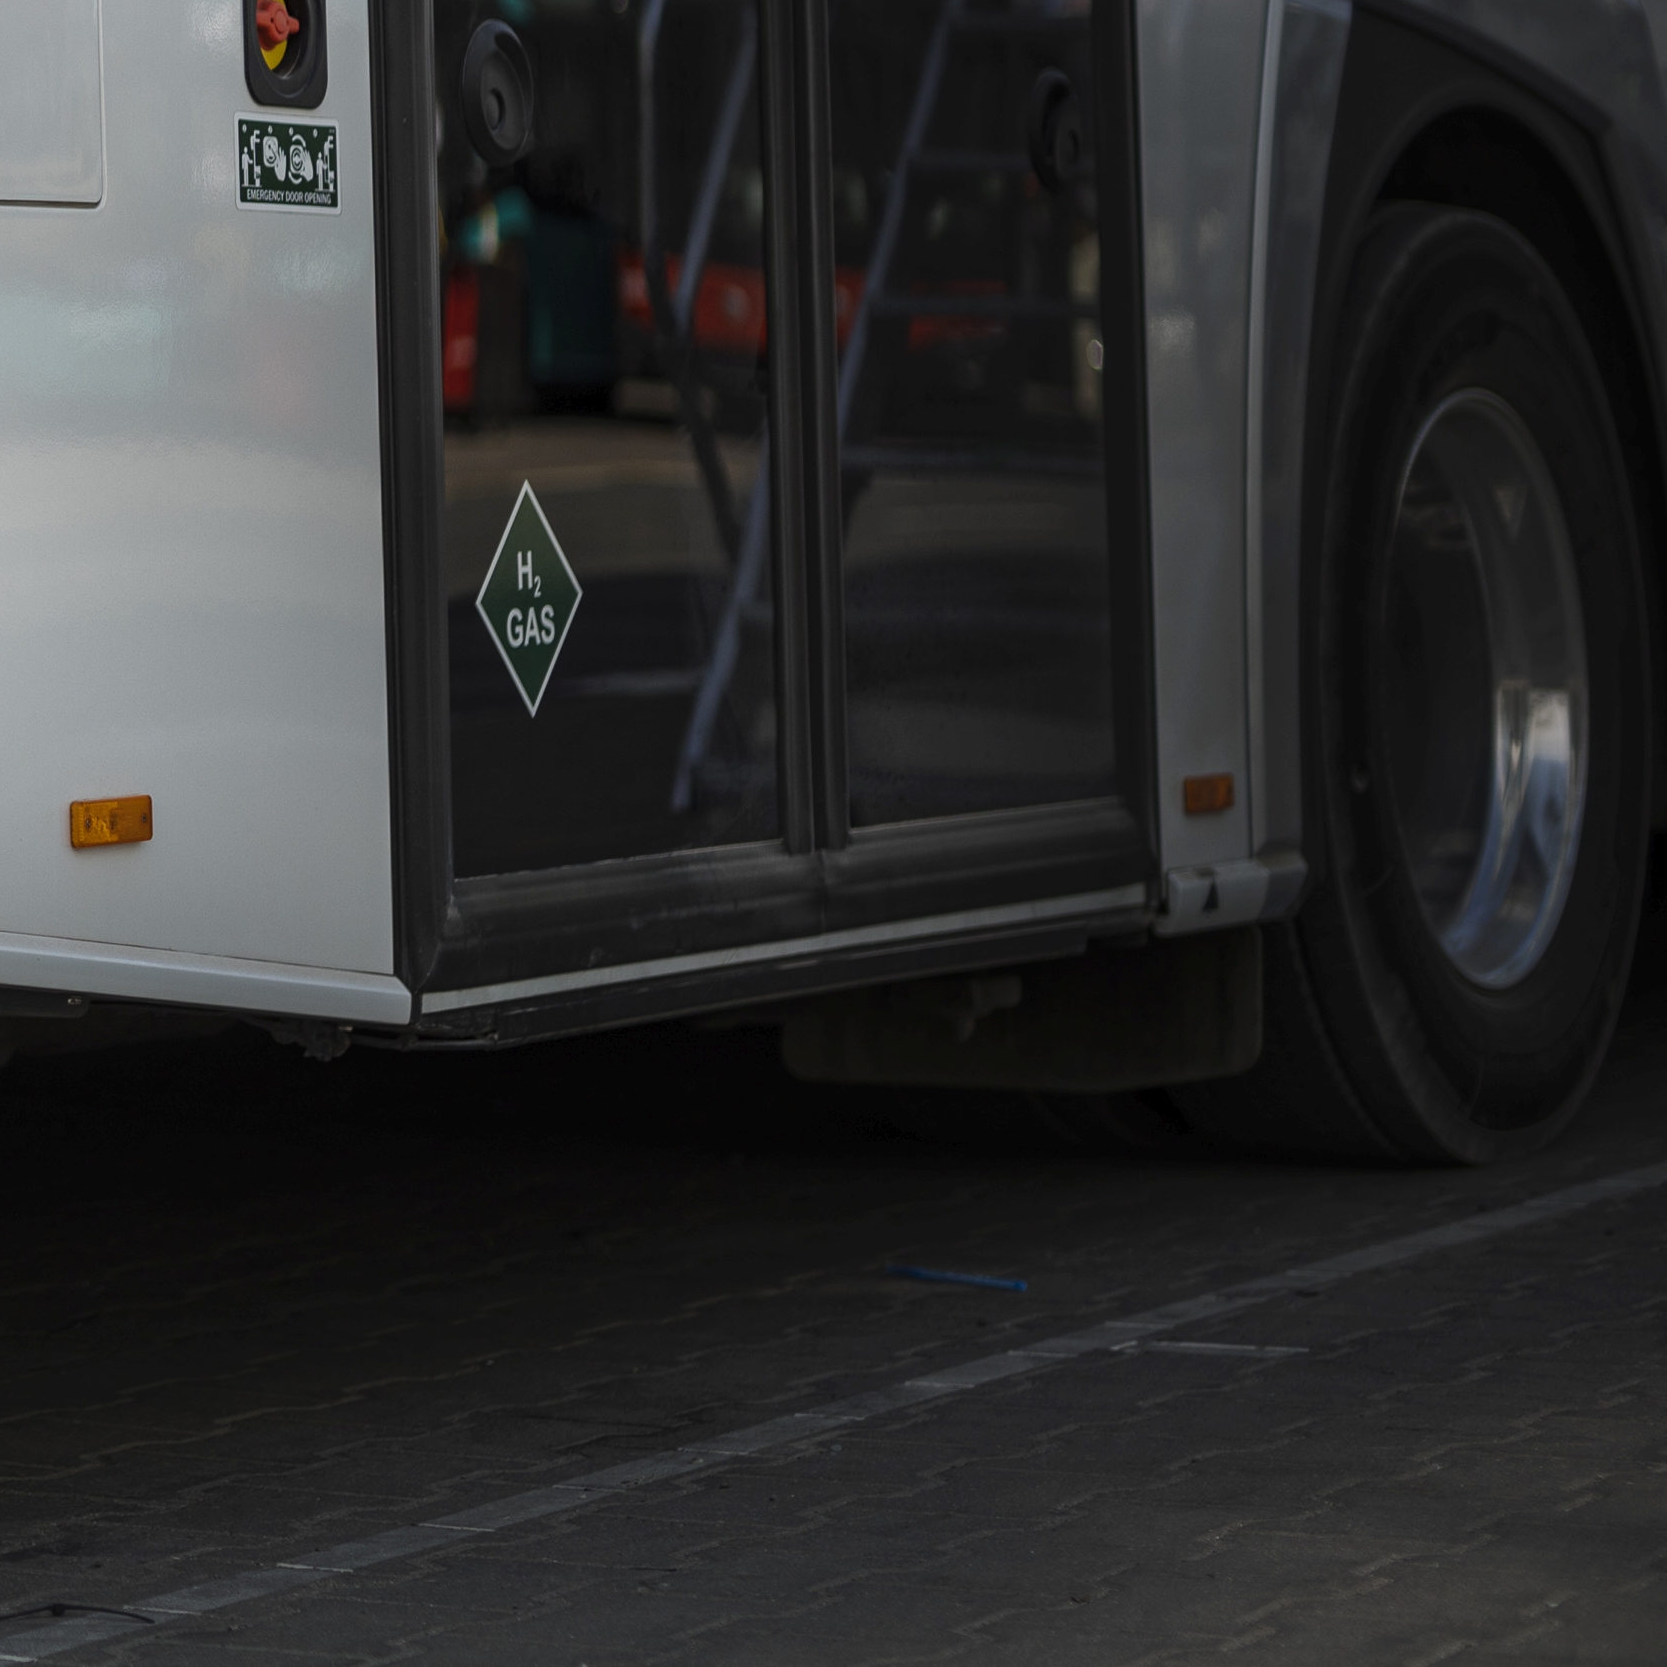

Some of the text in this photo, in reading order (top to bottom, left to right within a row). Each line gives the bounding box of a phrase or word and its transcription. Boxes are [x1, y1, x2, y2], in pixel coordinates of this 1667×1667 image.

[247, 189, 332, 205] EMERGENCY DOOR OPENING
[506, 604, 556, 649] GAS
